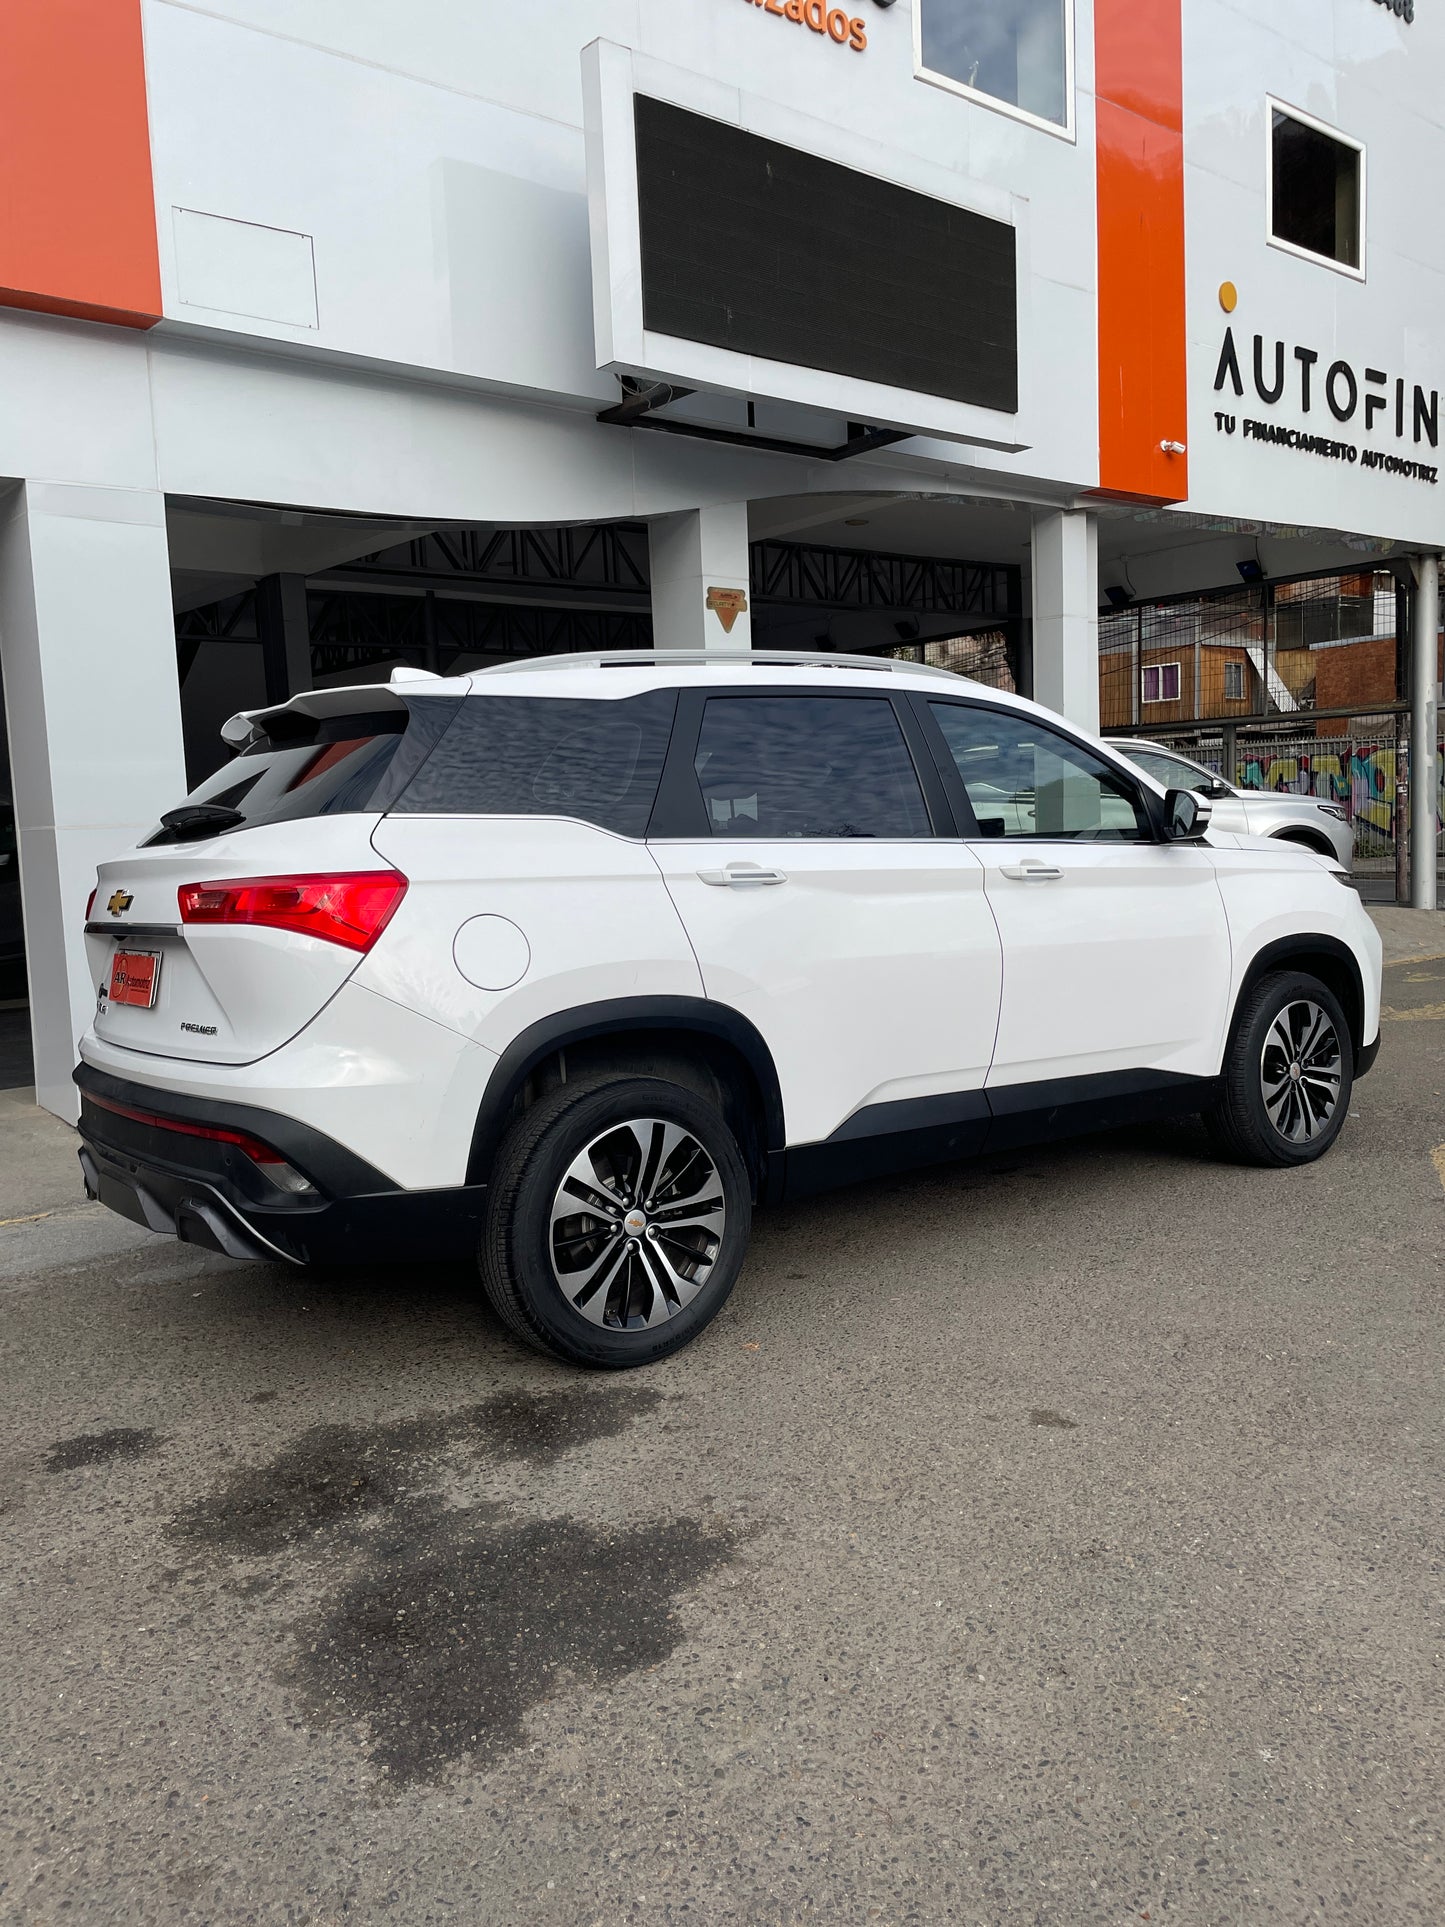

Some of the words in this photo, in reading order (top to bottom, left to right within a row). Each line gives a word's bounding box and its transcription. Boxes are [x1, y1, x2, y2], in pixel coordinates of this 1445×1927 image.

[1213, 326, 1439, 448] AUTOFIN
[1214, 411, 1236, 434] TU
[1243, 418, 1357, 462] FINANCIAMIENTO
[1360, 449, 1439, 484] AUTOMOTRIZ
[114, 971, 126, 984] AR
[180, 1022, 218, 1037] PREMIER
